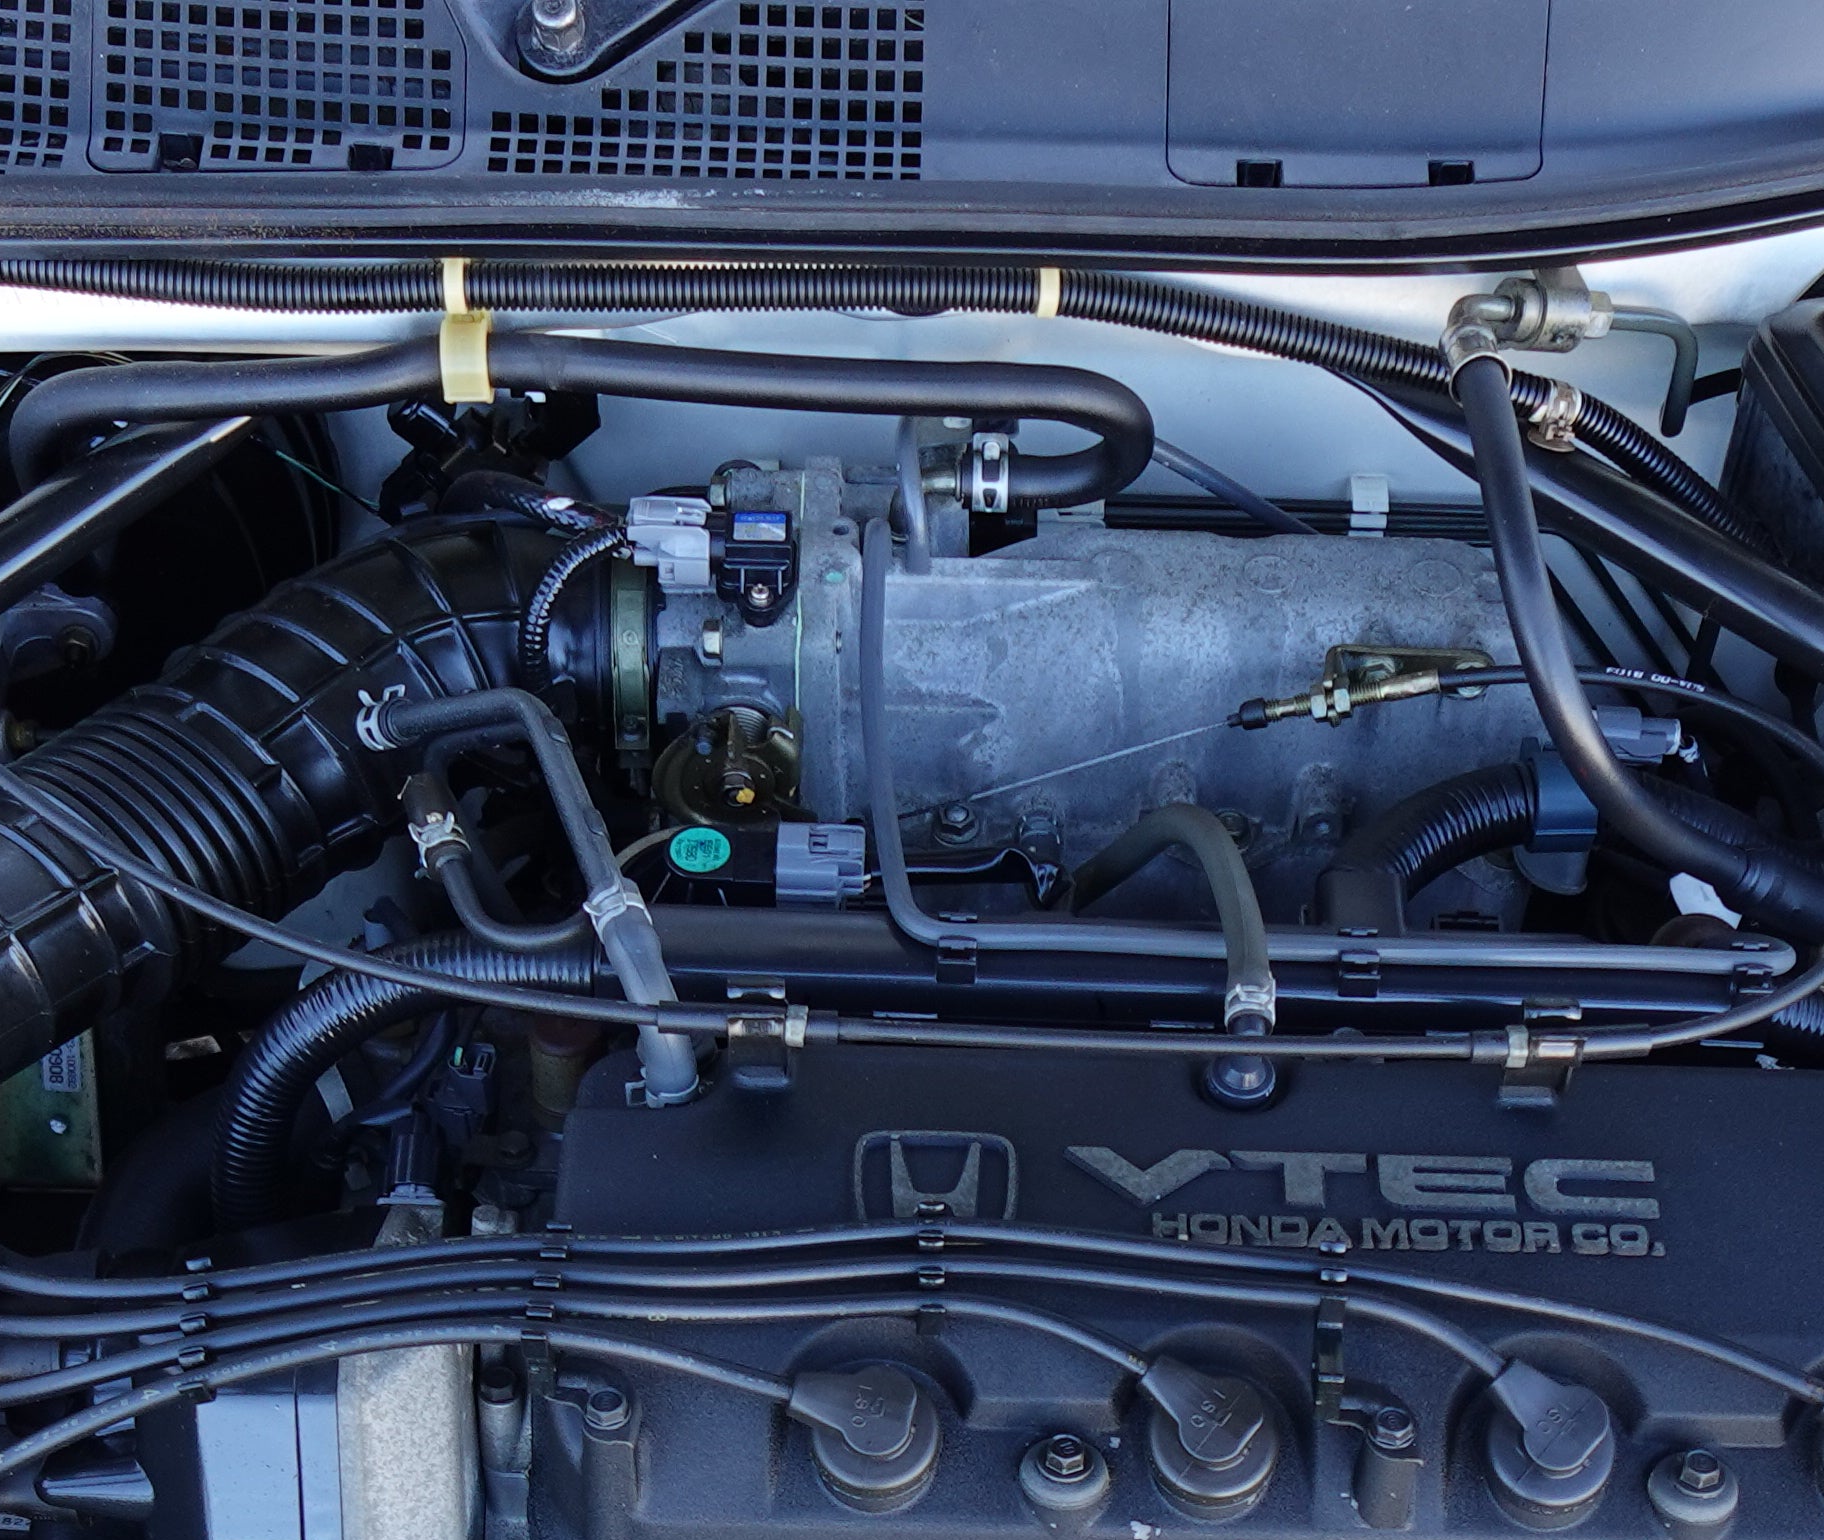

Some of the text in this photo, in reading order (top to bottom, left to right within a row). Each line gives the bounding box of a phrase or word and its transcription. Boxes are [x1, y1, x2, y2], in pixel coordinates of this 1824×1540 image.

[1063, 1146, 1660, 1220] VTEC
[1151, 1211, 1667, 1258] HONDA MOTOR CO.
